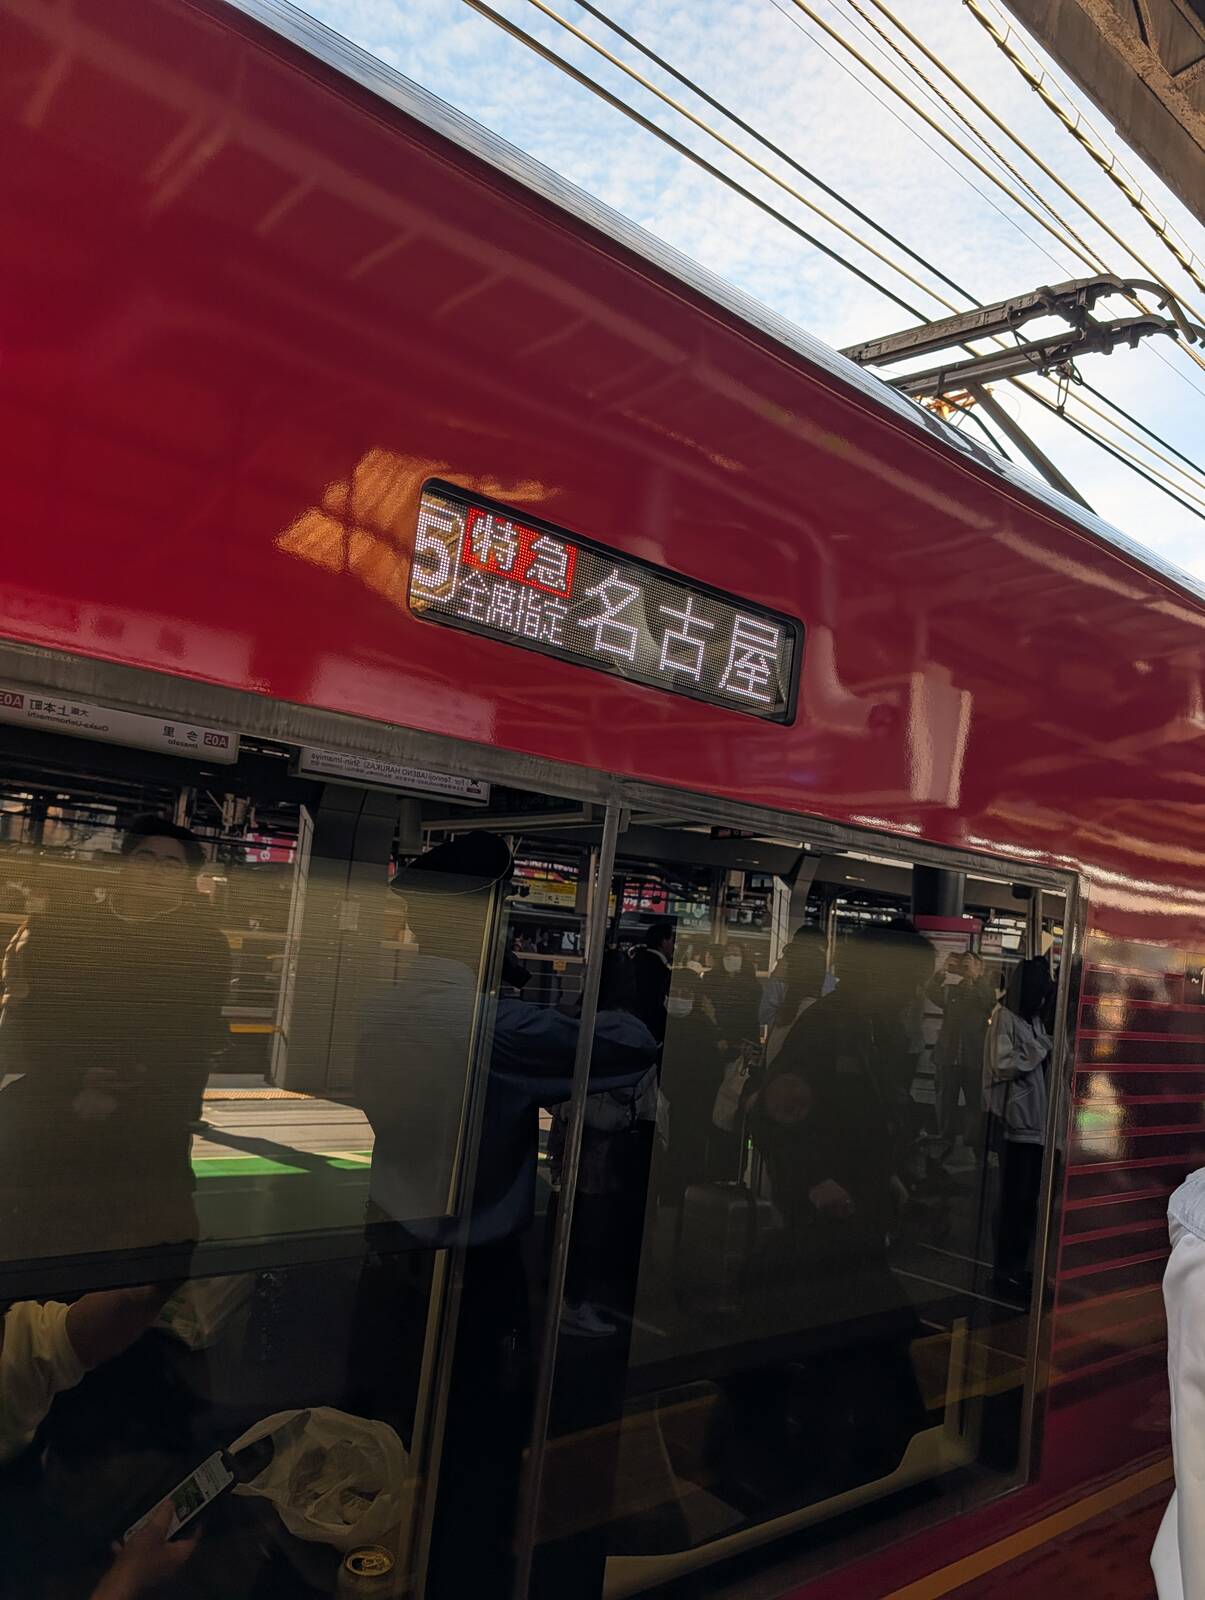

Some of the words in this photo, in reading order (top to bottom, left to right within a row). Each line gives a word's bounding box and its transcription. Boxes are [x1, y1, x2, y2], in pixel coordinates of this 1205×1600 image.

[413, 512, 452, 588] 5
[471, 514, 569, 591] 特急
[457, 570, 568, 646] 全席指定
[577, 569, 780, 702] 名古屋
